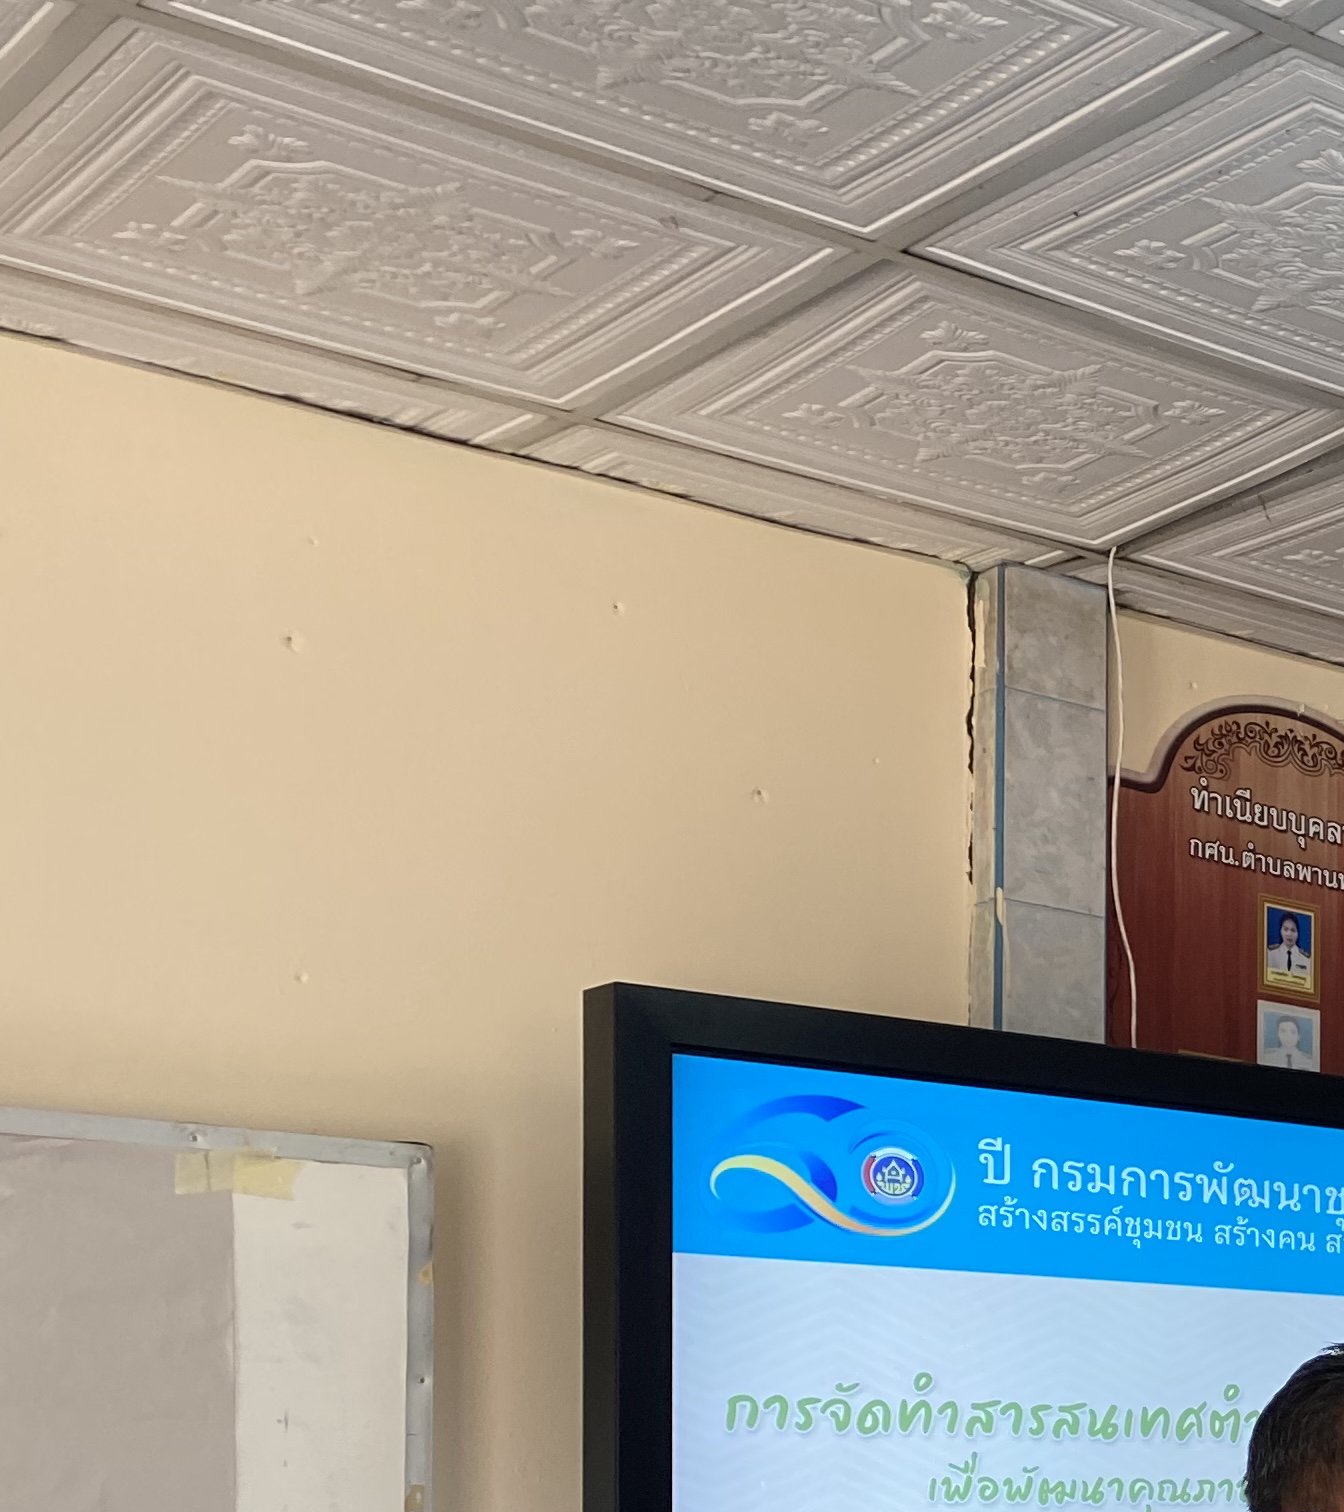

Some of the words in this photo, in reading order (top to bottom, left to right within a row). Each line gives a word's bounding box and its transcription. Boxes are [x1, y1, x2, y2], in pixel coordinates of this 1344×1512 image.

[976, 1135, 1012, 1188] ปี
[976, 1198, 1203, 1250] สร้างสรรค์ชุมชน
[1212, 1211, 1317, 1254] สร้างคน
